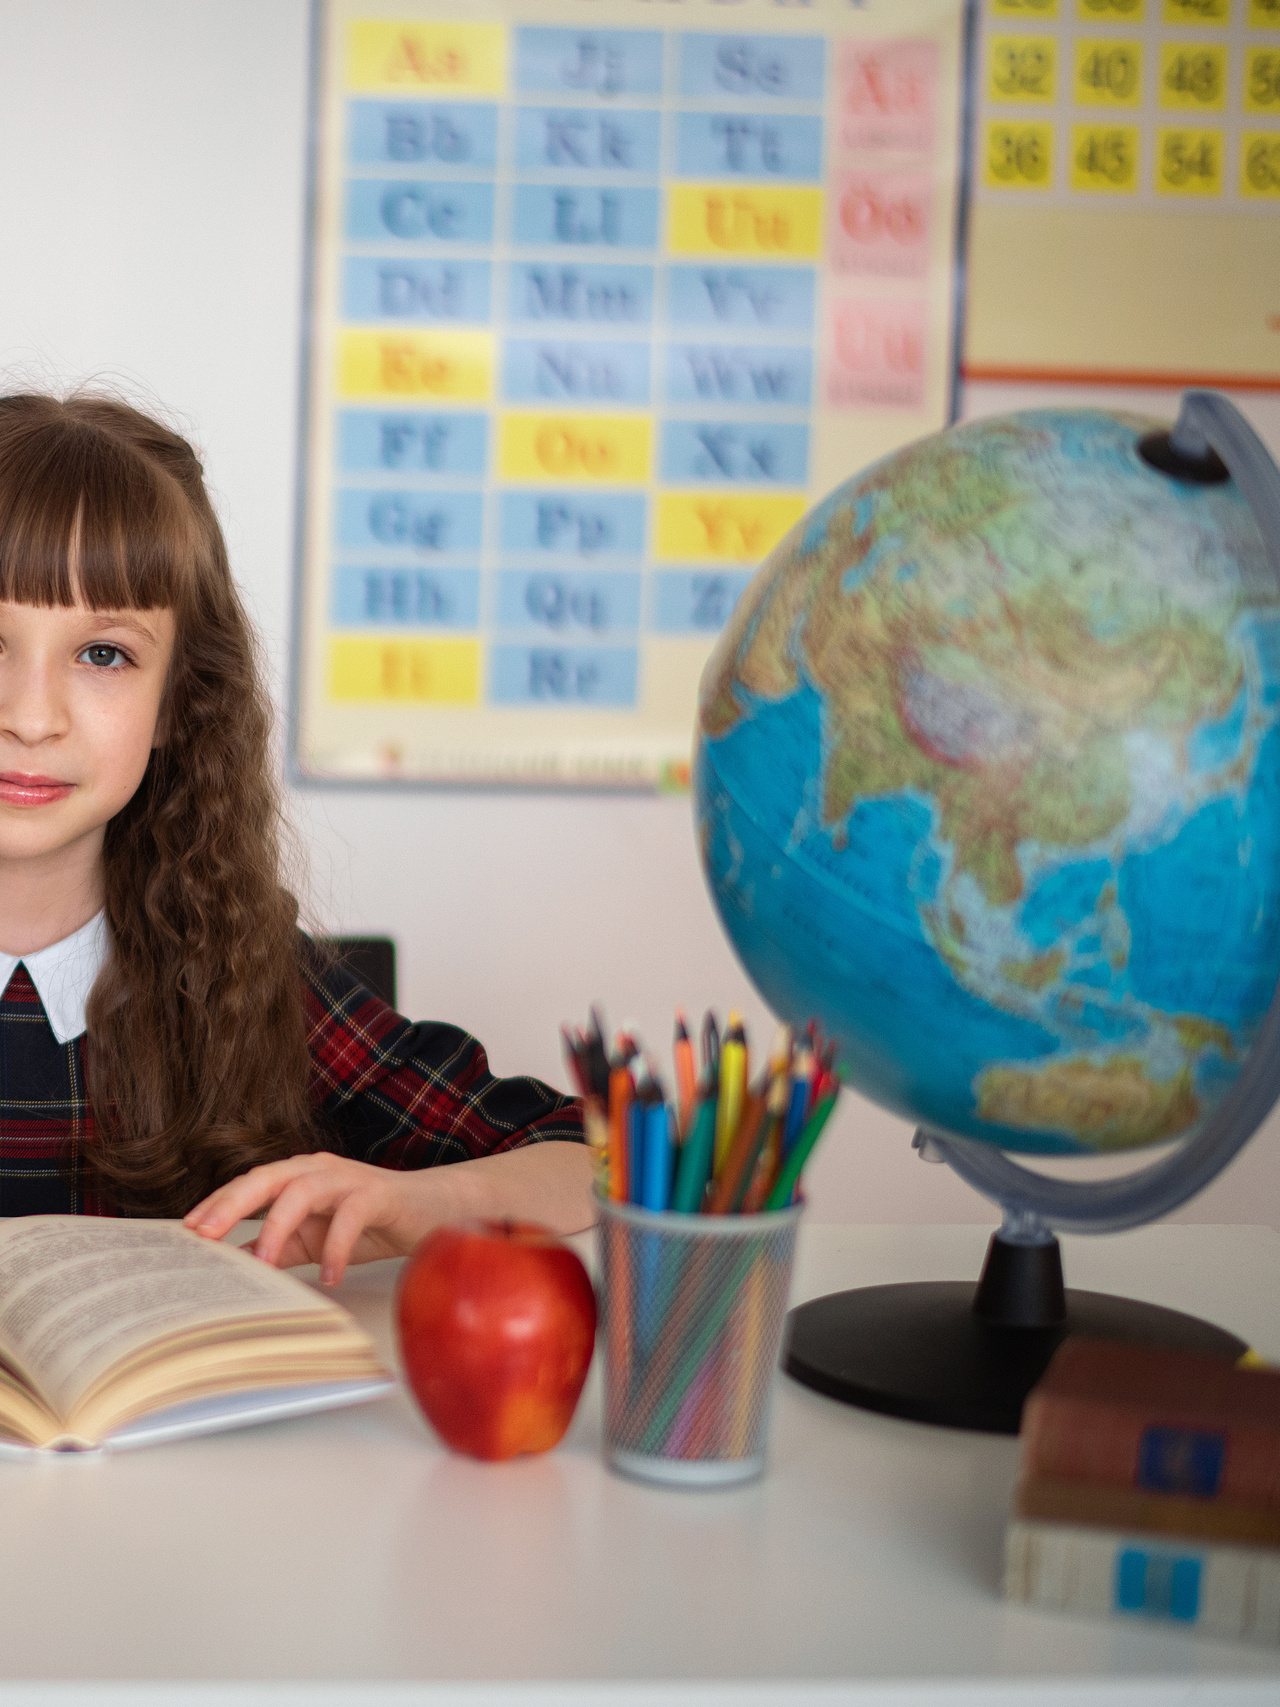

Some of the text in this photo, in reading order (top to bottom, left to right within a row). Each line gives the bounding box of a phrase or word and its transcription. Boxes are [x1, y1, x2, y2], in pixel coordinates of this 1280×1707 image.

[383, 34, 467, 84] Aa
[712, 37, 786, 93] Ss
[993, 43, 1053, 96] 32
[1080, 46, 1138, 99] 40
[1165, 51, 1221, 103] 48
[1251, 54, 1280, 106] 5
[383, 113, 472, 165] Bb
[541, 115, 637, 170] Kk
[710, 116, 786, 174] Tt
[990, 127, 1049, 182] 36
[1076, 130, 1133, 184] 45
[1163, 132, 1215, 187] 54
[377, 188, 466, 241] Cc
[551, 191, 620, 245] Ll
[702, 198, 798, 249] Uu
[375, 270, 463, 320] Dd
[526, 272, 641, 322] Mm
[698, 274, 782, 324] Vv
[376, 338, 456, 393] Ee
[685, 354, 789, 406] Ww
[377, 421, 447, 473] Ff
[532, 423, 616, 475] Oo
[693, 425, 779, 479] Xx
[365, 496, 449, 555] Gg
[532, 499, 610, 563] Pp
[693, 501, 764, 564] Yy
[361, 574, 453, 624] Hh
[522, 574, 610, 636] Qq
[527, 649, 600, 701] Rr
